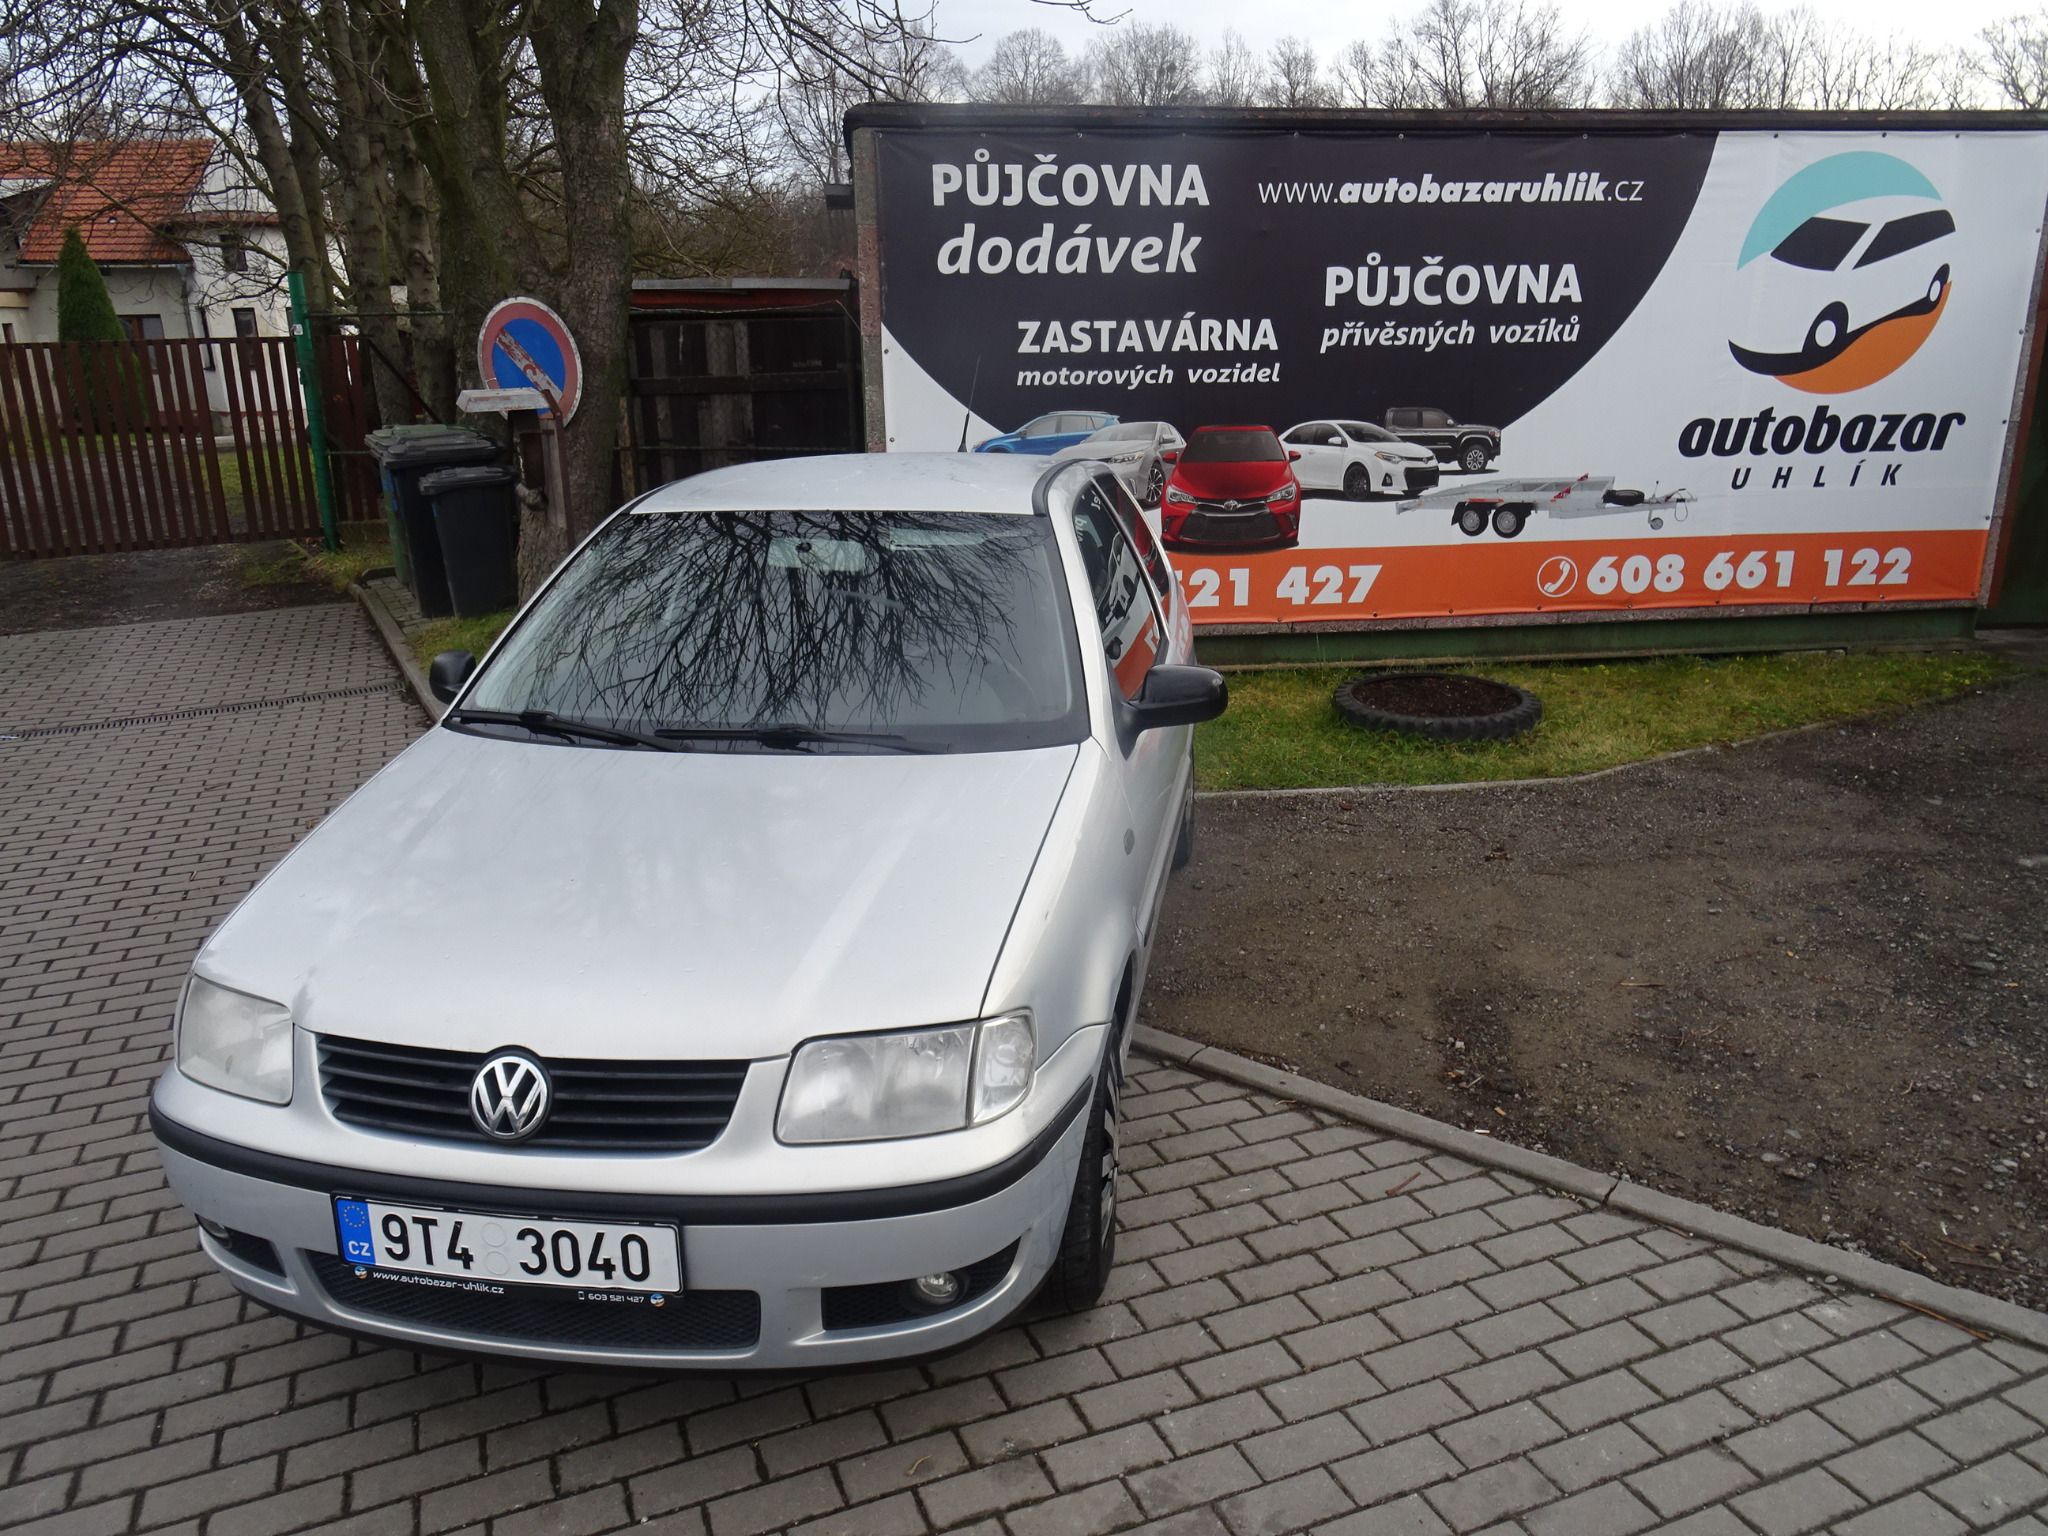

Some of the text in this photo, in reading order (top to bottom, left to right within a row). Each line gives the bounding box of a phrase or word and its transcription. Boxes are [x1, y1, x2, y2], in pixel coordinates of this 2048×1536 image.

[932, 148, 1210, 207] PŮJČOVNA
[1258, 172, 1644, 204] www.autobazaruhlik.cz
[937, 223, 1202, 275] dodávek
[1324, 252, 1583, 307] PŮJČOVNA
[1017, 311, 1279, 355] ZASTAVÁRNA
[1320, 315, 1581, 354] přívěsných vozíků
[1016, 362, 1281, 390] motorových vozidel
[1678, 405, 1967, 459] autobazar
[1176, 564, 1384, 608] 21 427
[1586, 547, 1913, 595] 608 661 122
[472, 1056, 548, 1140] VW
[348, 1240, 372, 1258] CZ
[381, 1213, 651, 1283] 9T4 3040
[372, 1270, 505, 1294] www.autobazar-uhlik.cz
[588, 1293, 608, 1301] 603
[609, 1294, 625, 1302] 521
